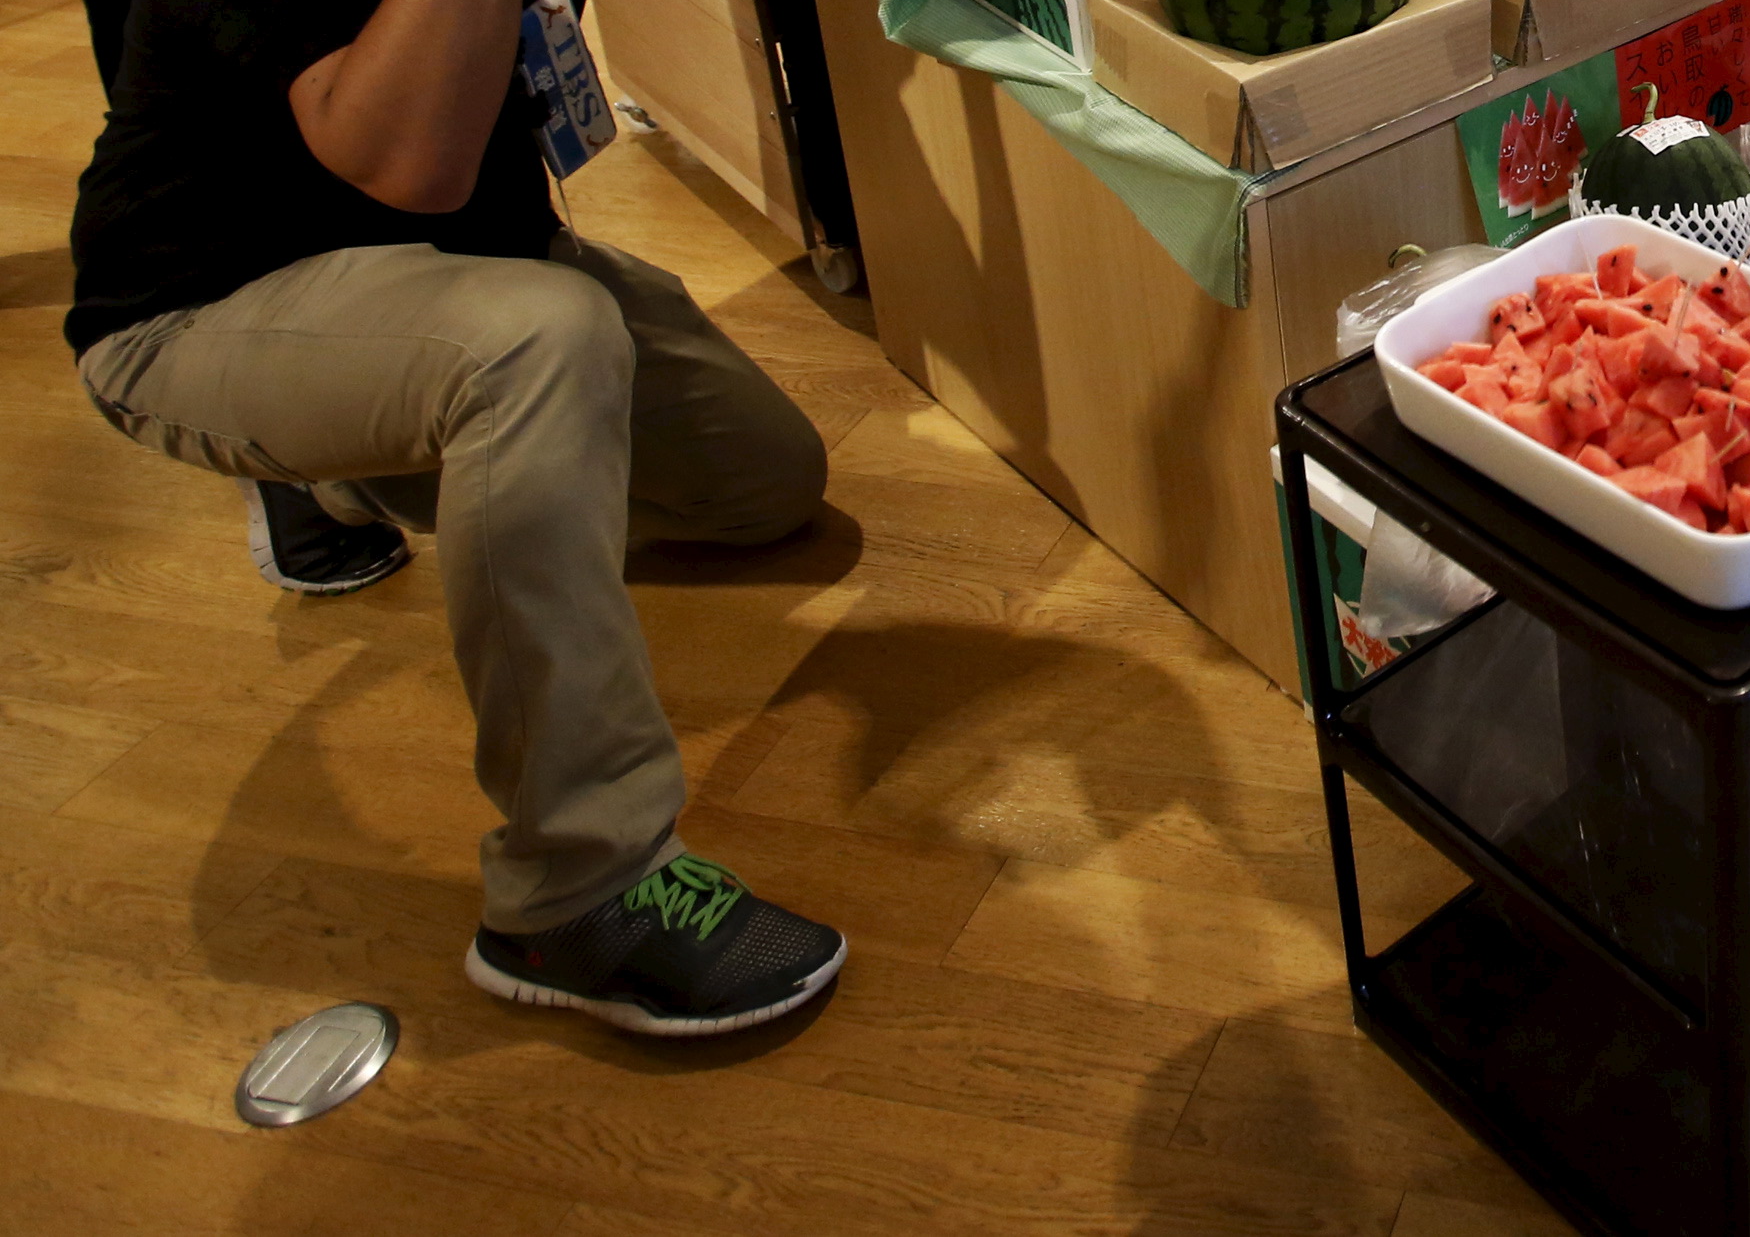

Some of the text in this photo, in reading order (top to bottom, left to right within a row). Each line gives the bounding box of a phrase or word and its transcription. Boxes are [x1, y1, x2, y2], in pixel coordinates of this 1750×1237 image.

[553, 22, 602, 128] TBS
[1681, 25, 1708, 108] 鳥取の
[1705, 14, 1727, 56] 甘い
